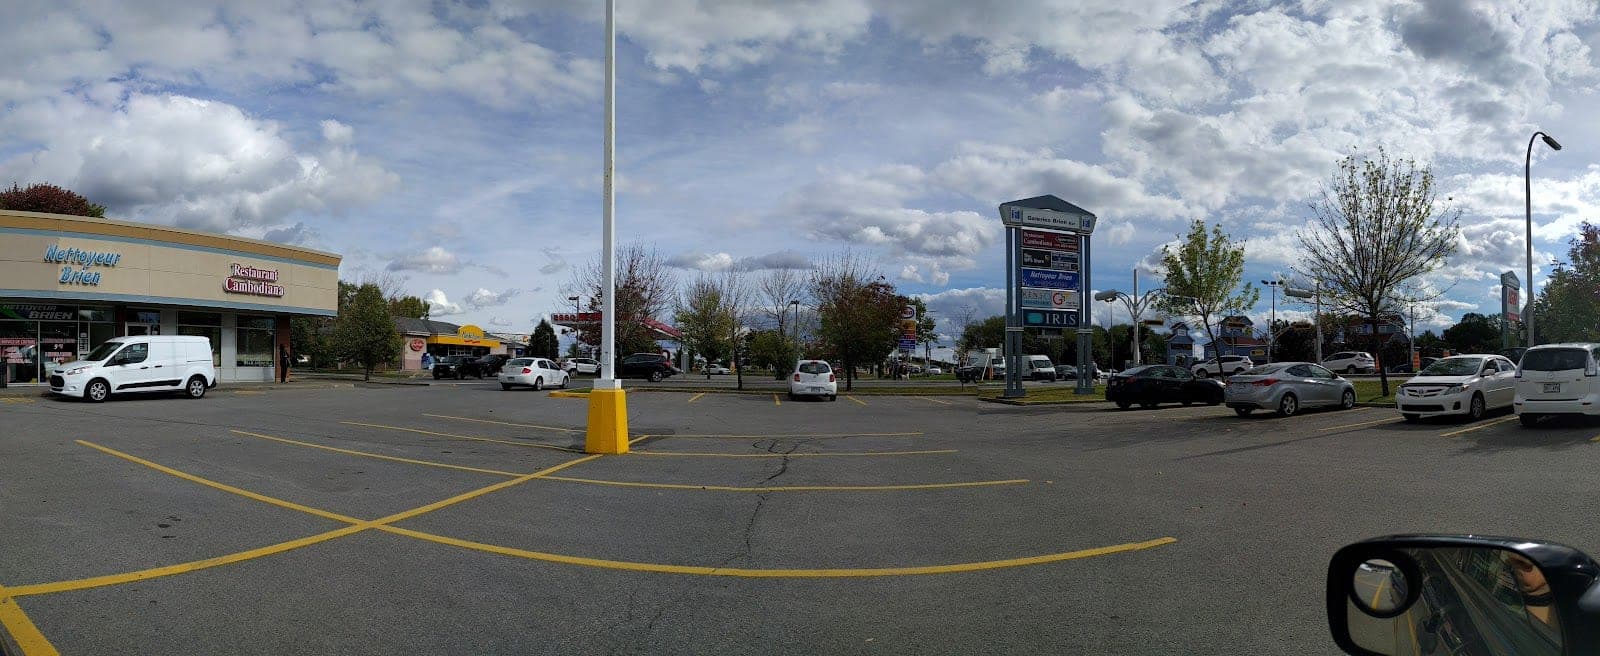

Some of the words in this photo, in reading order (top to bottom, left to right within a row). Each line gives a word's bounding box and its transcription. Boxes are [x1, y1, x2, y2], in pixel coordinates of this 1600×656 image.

[44, 244, 121, 268] Nettoyeur
[59, 266, 102, 287] Brien
[232, 263, 279, 281] Restaurant
[224, 277, 285, 297] Cambodiana
[28, 310, 73, 320] BRIEN
[1046, 313, 1077, 326] IRIS
